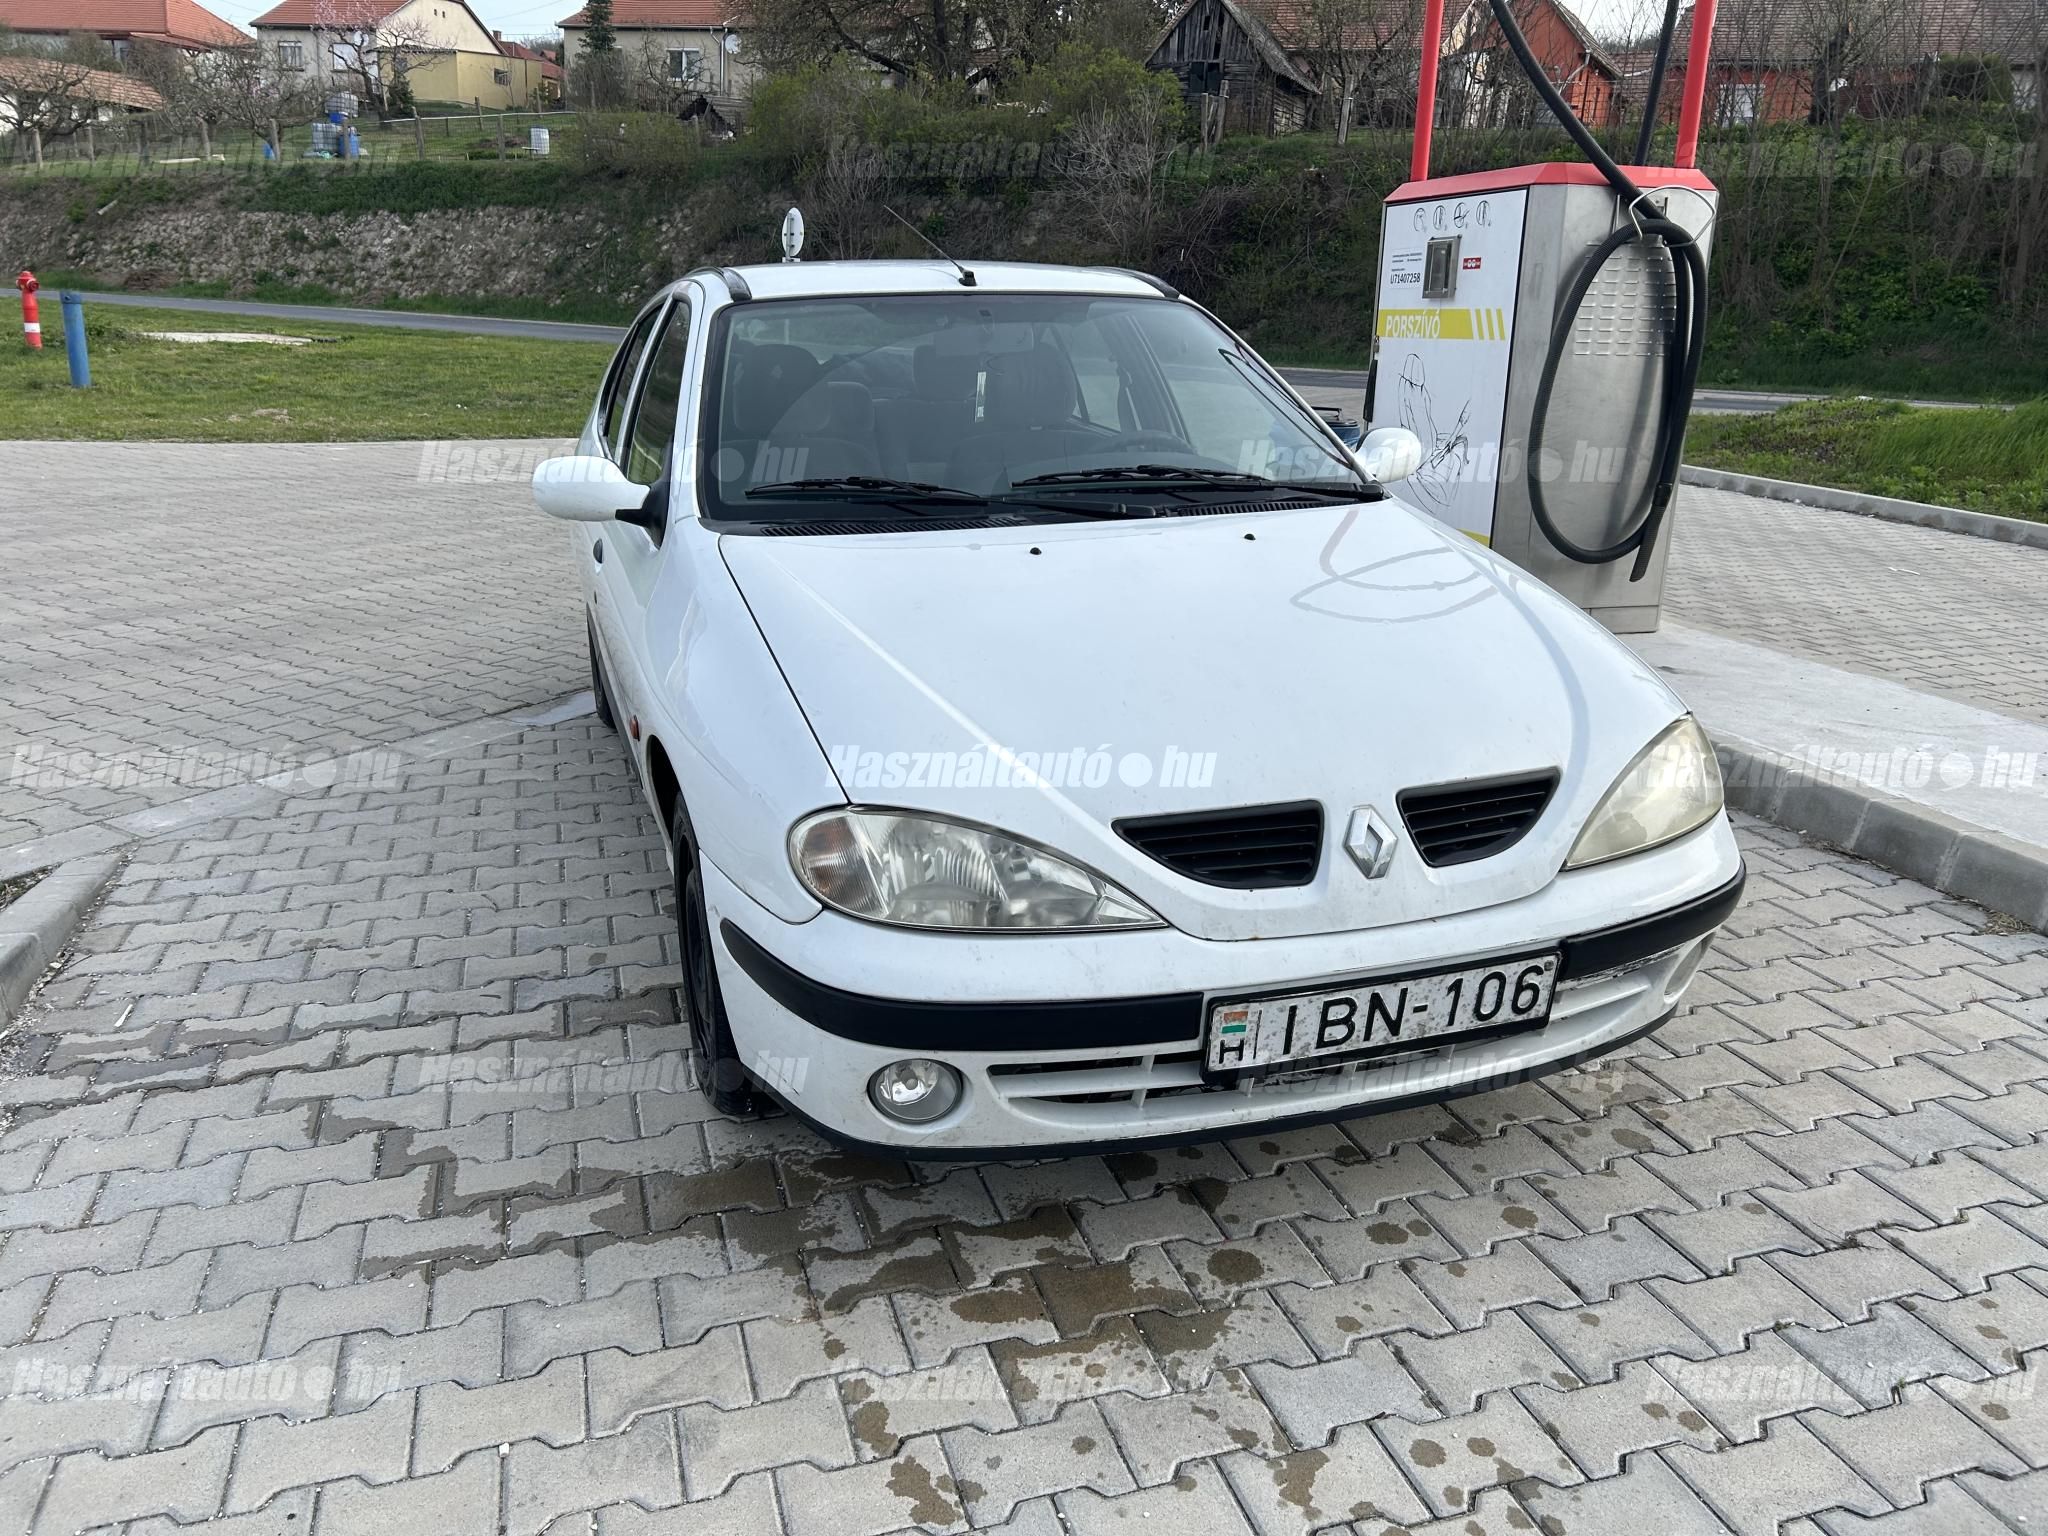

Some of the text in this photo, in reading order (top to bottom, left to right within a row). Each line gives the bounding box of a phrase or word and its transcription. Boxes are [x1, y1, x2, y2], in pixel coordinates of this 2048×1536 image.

[1385, 309, 1440, 338] PORSZÍVÓ
[1219, 964, 1545, 1064] H IBN-106
